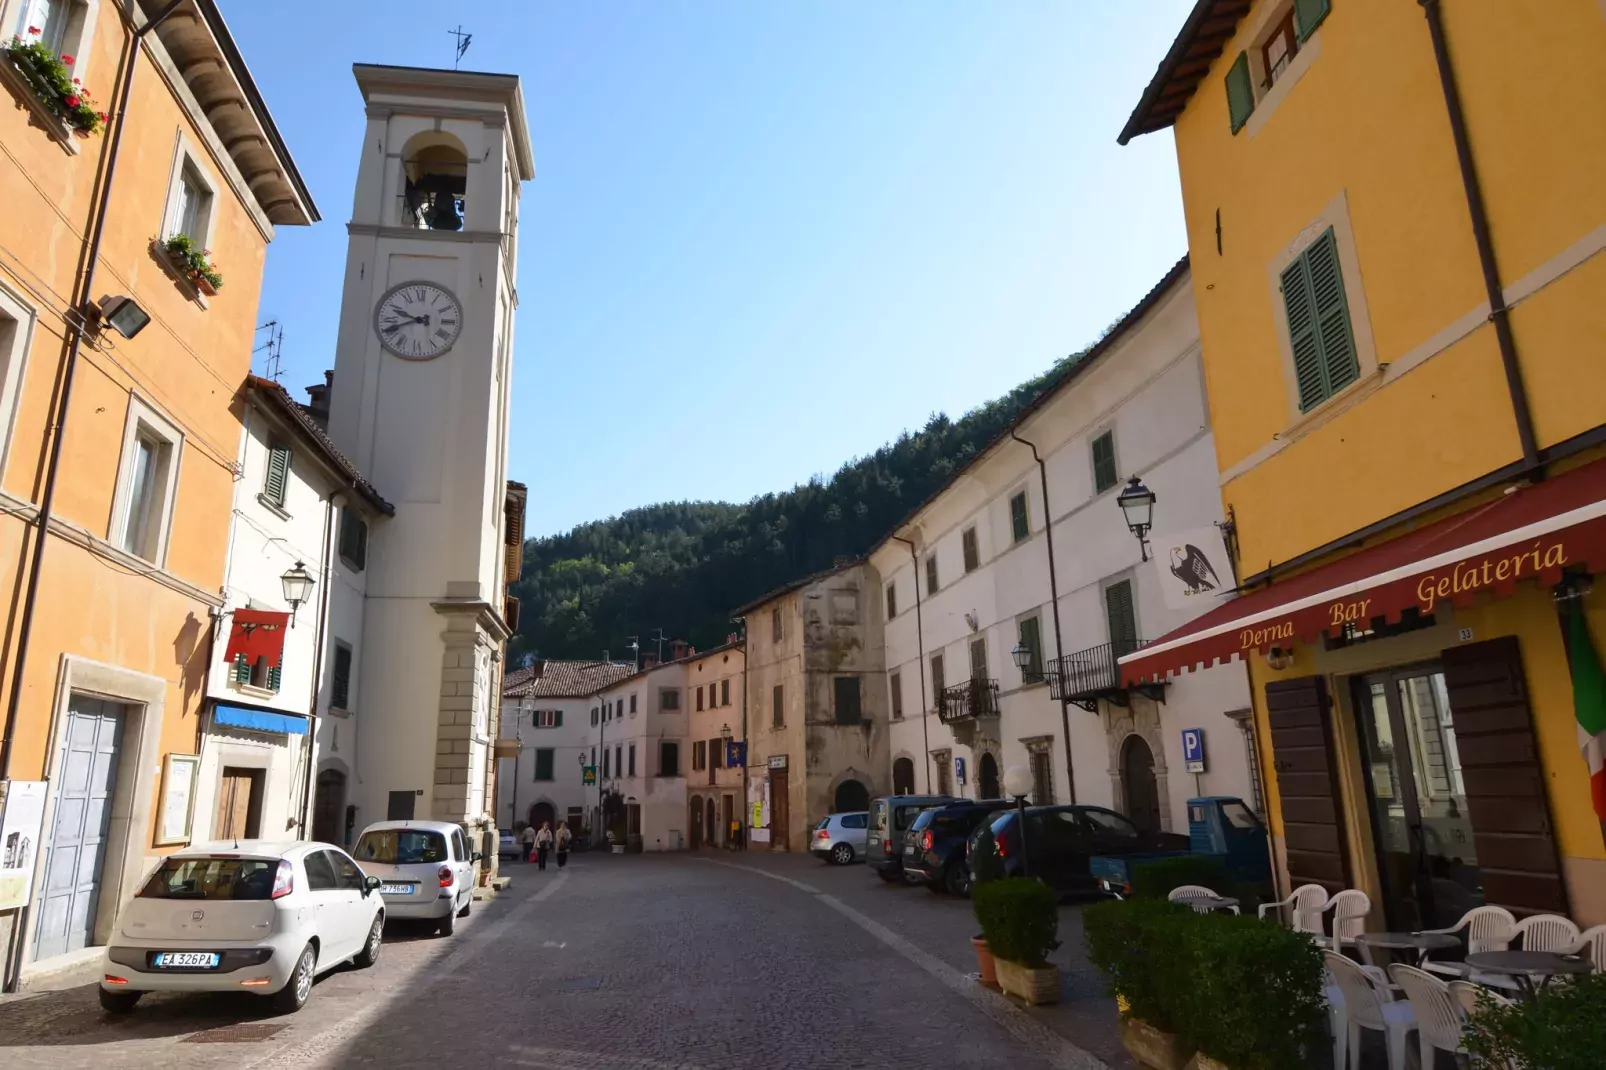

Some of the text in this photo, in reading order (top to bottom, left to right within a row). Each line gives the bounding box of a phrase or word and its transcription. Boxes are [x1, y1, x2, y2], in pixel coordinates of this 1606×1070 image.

[1240, 541, 1568, 649] Derna Bar Gelateria
[1185, 732, 1197, 758] P
[162, 953, 212, 965] EA 326PA
